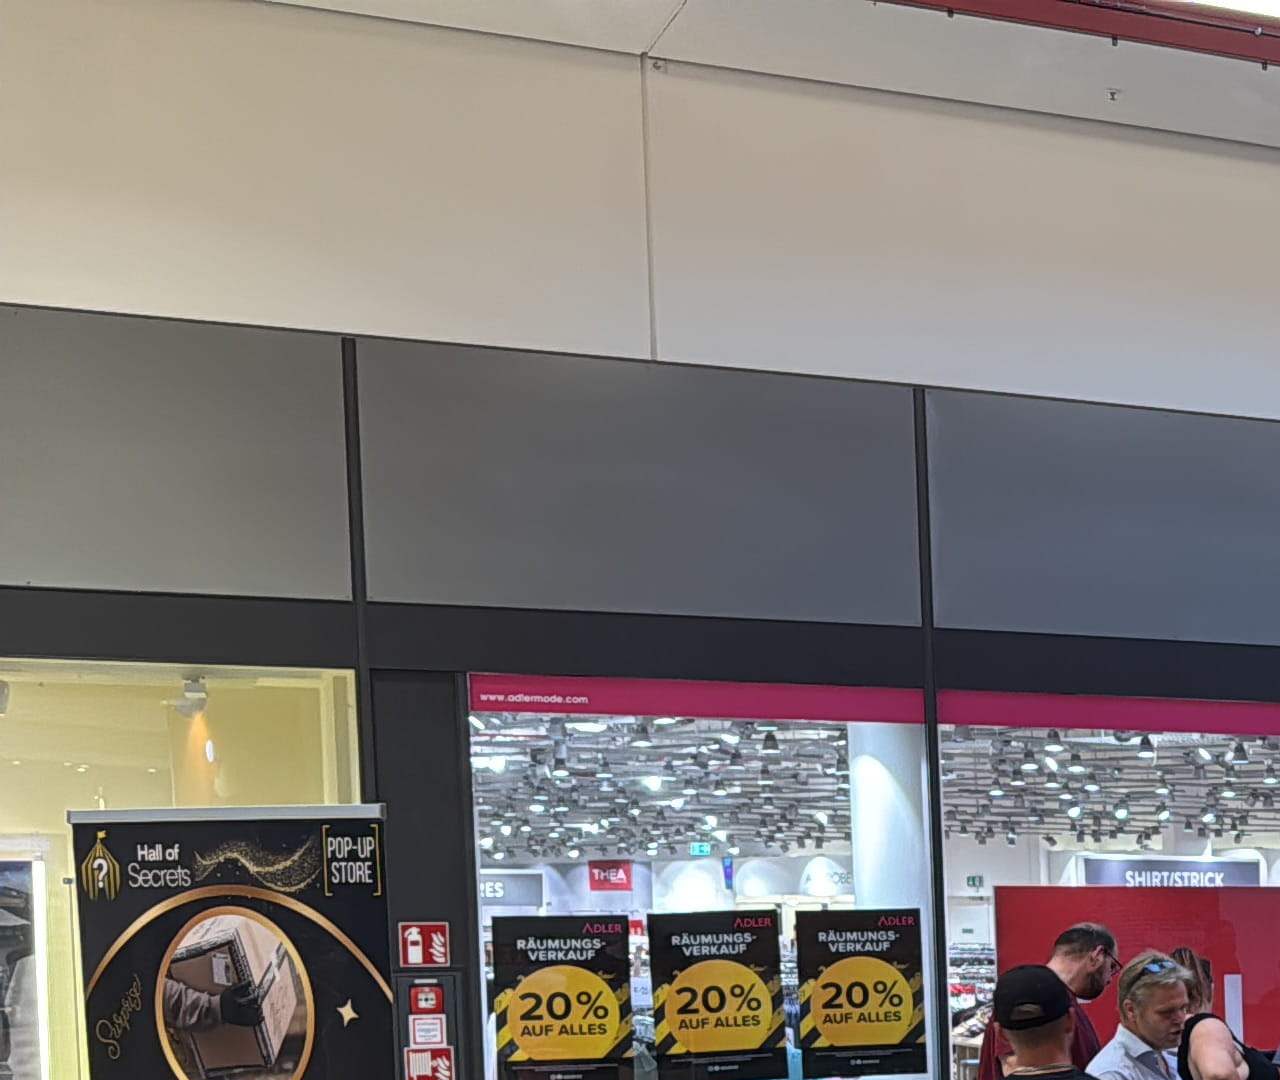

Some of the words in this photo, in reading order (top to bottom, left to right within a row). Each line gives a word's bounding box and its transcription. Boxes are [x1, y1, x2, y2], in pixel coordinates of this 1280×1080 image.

[480, 693, 589, 705] www.adlermode.com
[136, 843, 163, 862] Hall
[165, 843, 180, 861] of
[327, 836, 375, 859] POP-UP
[127, 862, 192, 888] Secrets
[331, 861, 374, 885] STORE
[1125, 870, 1225, 887] SHIRT/STRICK
[582, 922, 623, 935] ADLER
[733, 917, 773, 929] ADLER
[877, 915, 916, 927] ADLER
[516, 937, 607, 951] RÄUMUNGS-
[671, 932, 758, 947] RÄUMUNGS-
[817, 930, 900, 944] RÄUMUNGS-
[681, 944, 748, 957] VERKAUF
[827, 941, 892, 953] VERKAUF
[527, 950, 597, 962] VERKAUF
[675, 983, 762, 1016] 20%
[820, 979, 904, 1011] 20%
[518, 990, 610, 1022] 20%
[678, 1017, 710, 1031] AUF
[713, 1014, 761, 1028] ALLES
[822, 1012, 854, 1025] AUF
[856, 1010, 903, 1023] ALLES
[520, 1024, 554, 1037] AUF
[557, 1023, 608, 1036] ALLES
